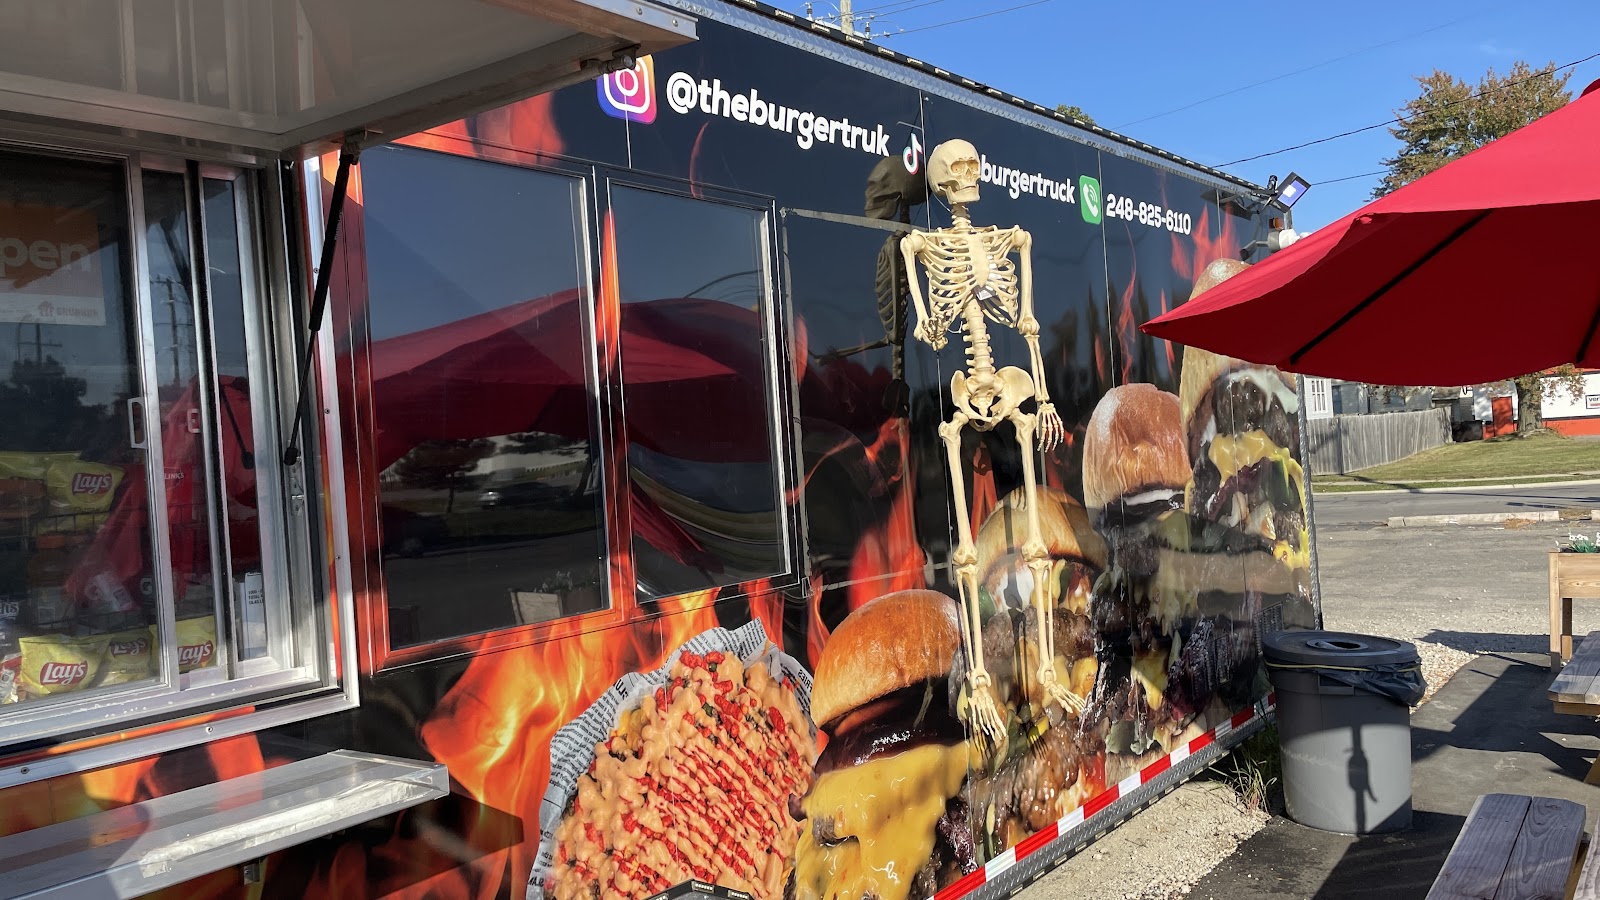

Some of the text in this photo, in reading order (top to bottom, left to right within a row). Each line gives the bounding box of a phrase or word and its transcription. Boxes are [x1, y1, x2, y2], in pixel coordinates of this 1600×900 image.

[666, 71, 890, 157] @theburgertruk
[979, 155, 1076, 204] burgertruck
[1106, 194, 1191, 236] 248-825-6110
[0, 237, 92, 278] pen
[113, 640, 146, 656] Lays
[42, 661, 87, 686] Lay's
